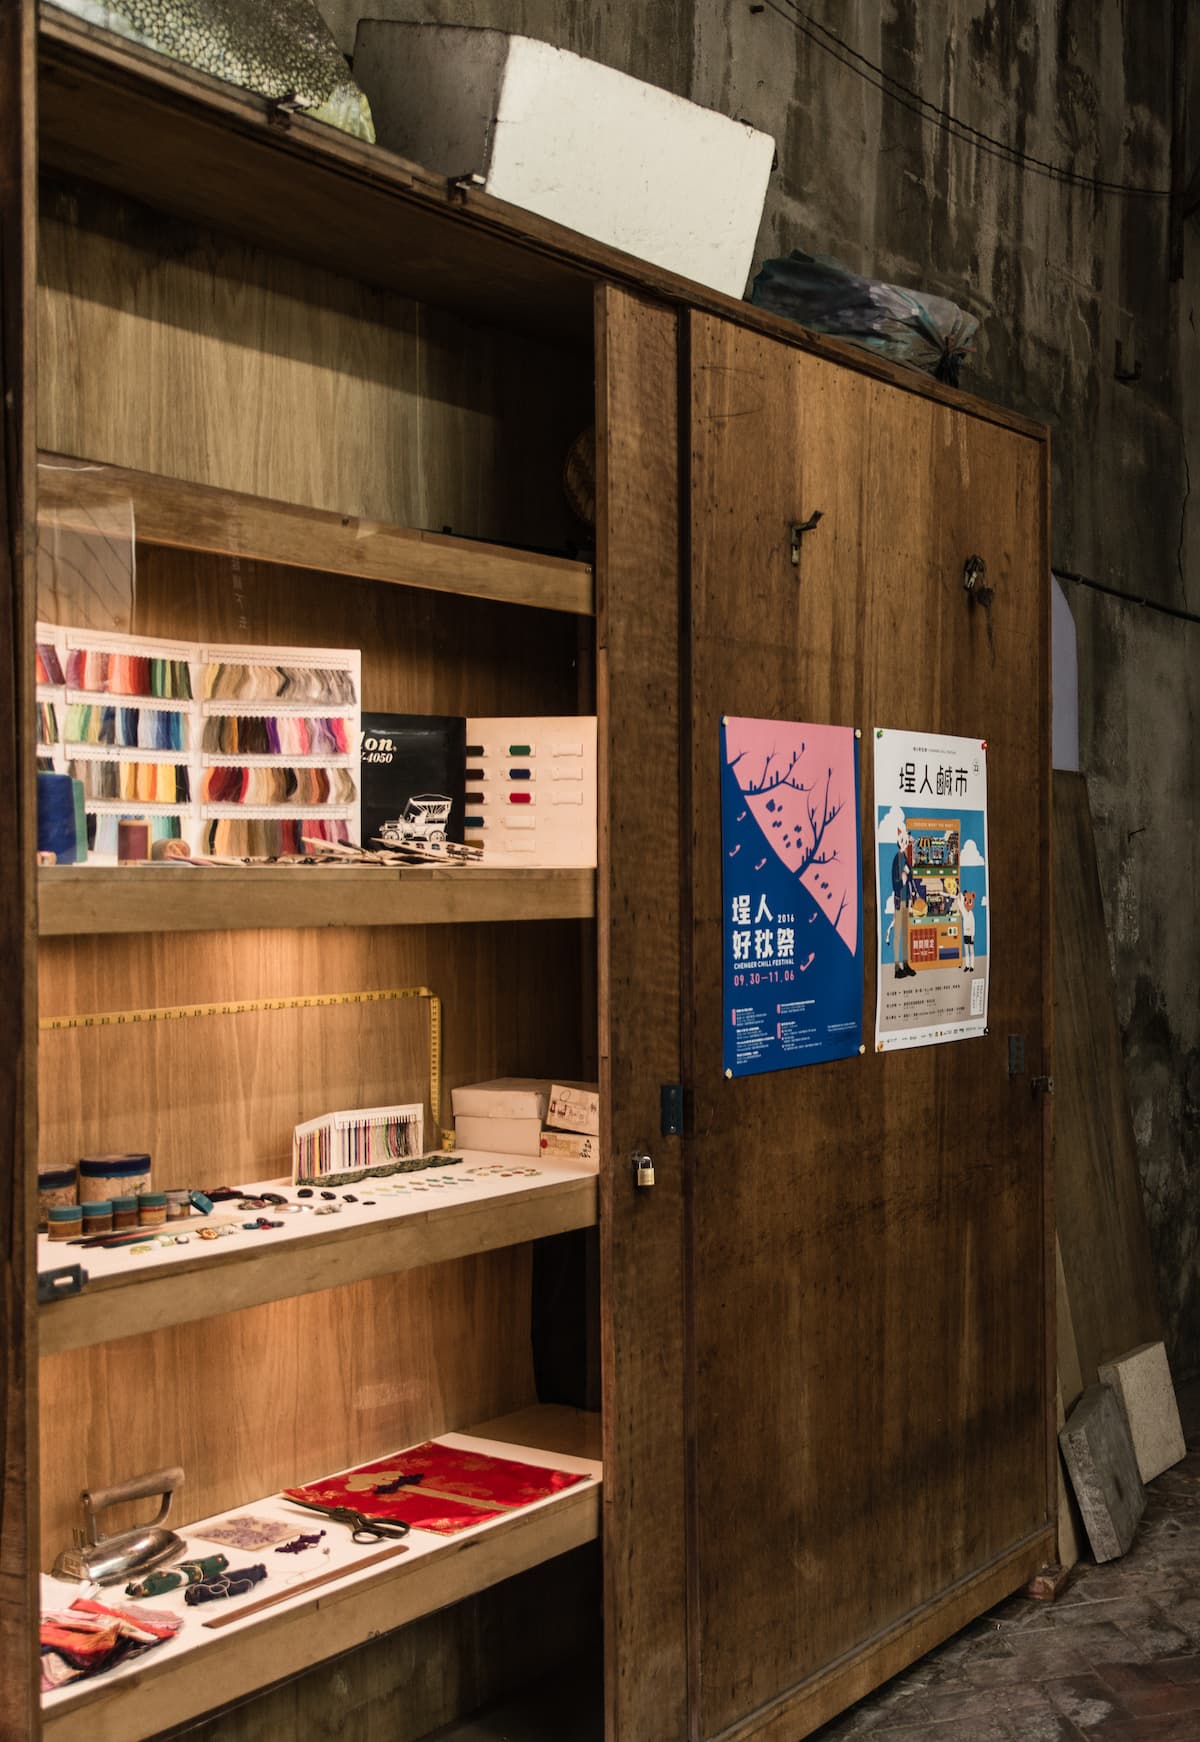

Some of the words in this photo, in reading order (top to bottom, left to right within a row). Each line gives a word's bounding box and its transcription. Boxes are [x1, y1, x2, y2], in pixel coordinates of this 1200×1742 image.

[732, 893, 774, 925] 埕人
[777, 914, 795, 923] 2016
[732, 927, 795, 960] 好秋祭
[757, 960, 772, 968] CHILL
[772, 958, 795, 966] FESTIVAL
